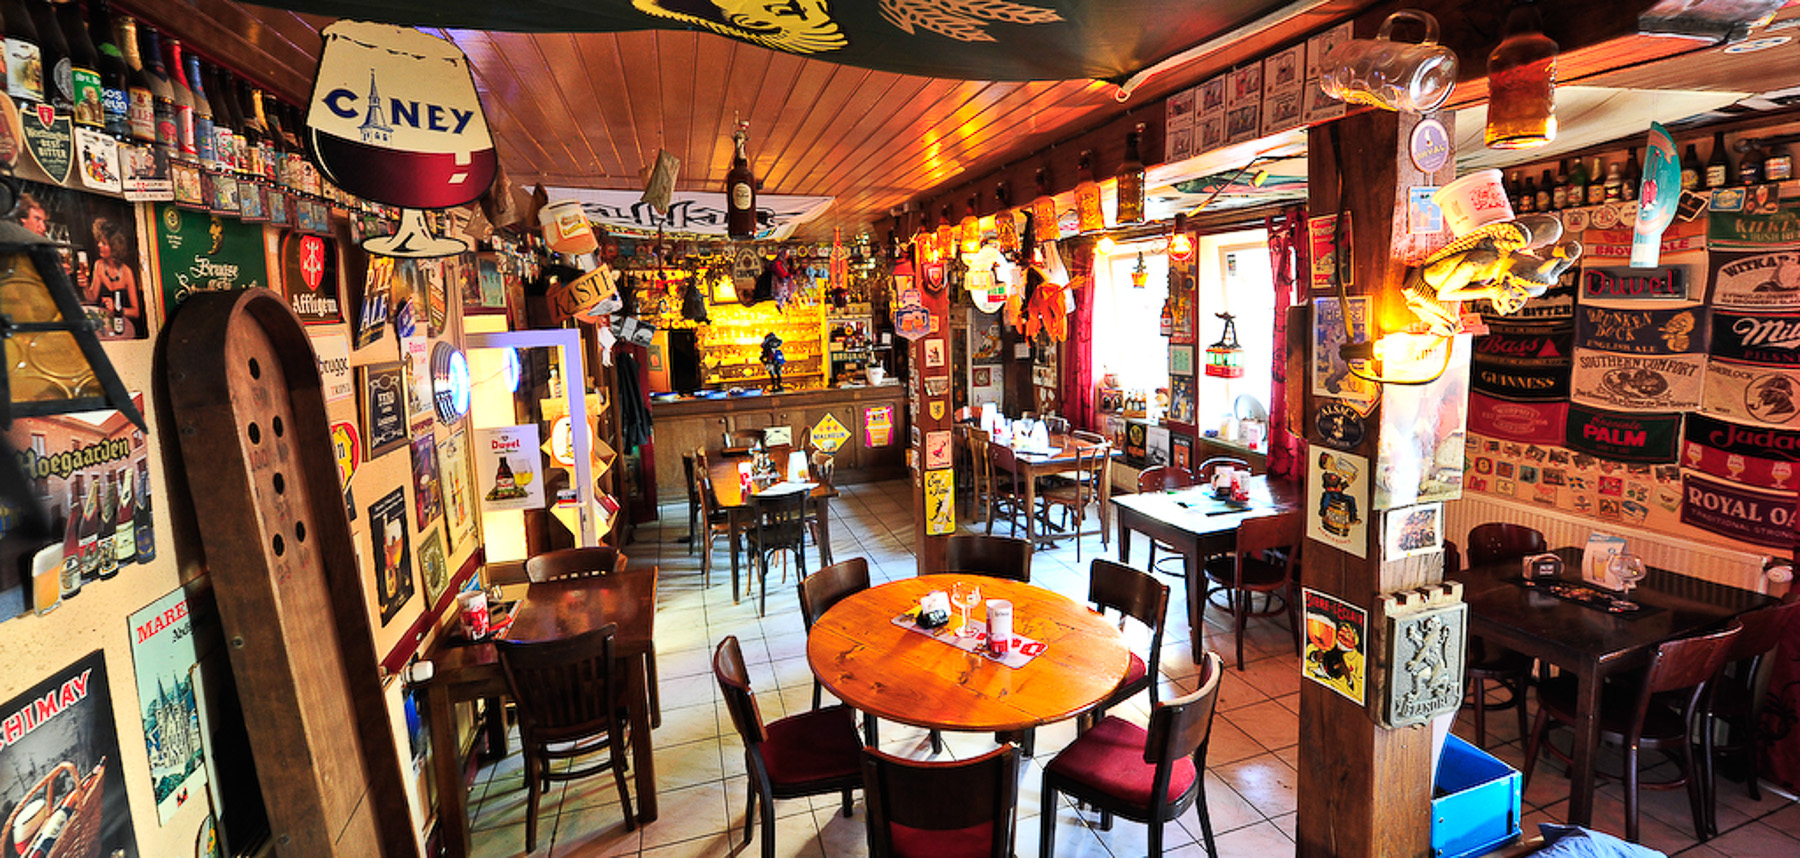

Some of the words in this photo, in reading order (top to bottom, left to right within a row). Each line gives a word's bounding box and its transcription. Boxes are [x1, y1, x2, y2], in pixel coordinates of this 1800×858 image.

[1736, 219, 1800, 233] KILKE
[1584, 269, 1676, 295] Duvel
[293, 294, 338, 317] Affligem
[1524, 304, 1571, 317] BITTER
[1478, 335, 1539, 353] Bass
[1580, 356, 1641, 369] SOUTHERN
[1643, 359, 1699, 377] COMFORT
[1481, 371, 1556, 389] GUINNESS
[1321, 404, 1358, 424] ALSACE
[491, 439, 520, 450] Duvel
[1583, 424, 1647, 447] PALM
[1709, 425, 1800, 450] Juda
[17, 439, 129, 481] Hoegaarden
[1688, 487, 1762, 522] ROYAL
[0, 668, 92, 749] HIMAY
